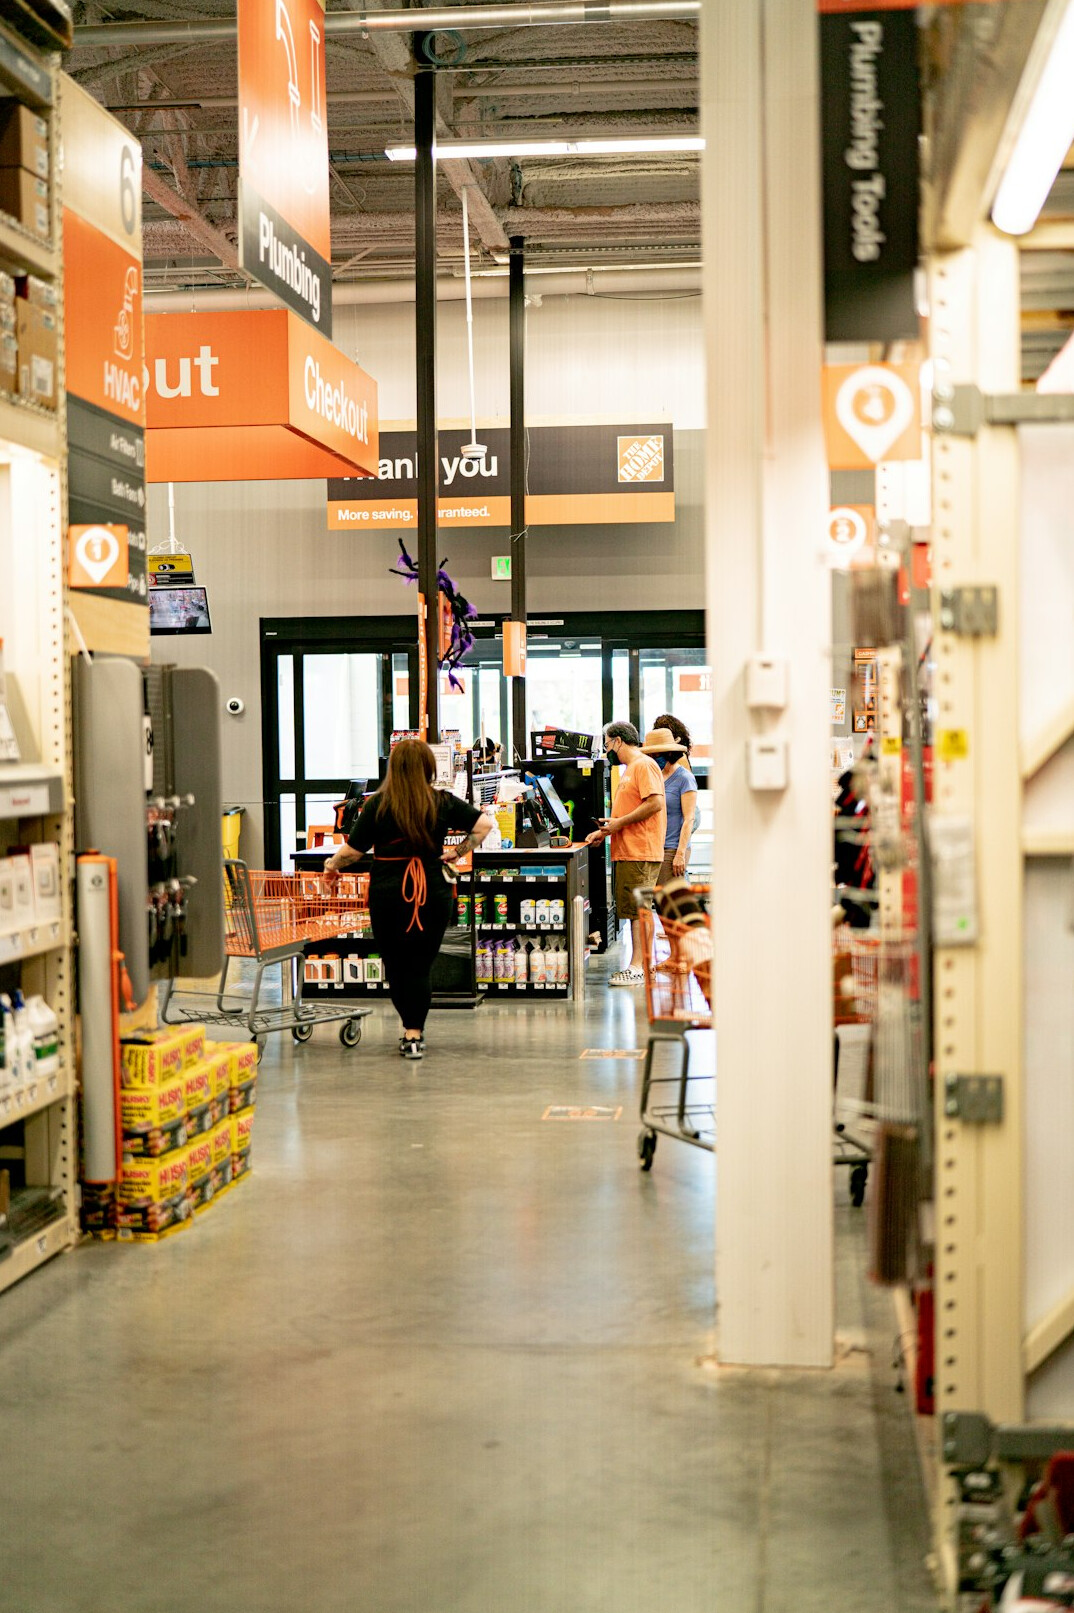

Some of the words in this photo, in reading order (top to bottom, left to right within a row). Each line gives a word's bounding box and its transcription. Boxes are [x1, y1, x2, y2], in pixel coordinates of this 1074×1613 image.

[845, 20, 884, 170] Plumbing
[121, 145, 137, 236] 6
[852, 173, 886, 262] Tools
[259, 211, 321, 323] Plumbing
[104, 360, 140, 412] HVAC
[304, 355, 369, 445] Checkout
[337, 509, 369, 521] More
[371, 507, 414, 523] saving.
[441, 455, 498, 486] you
